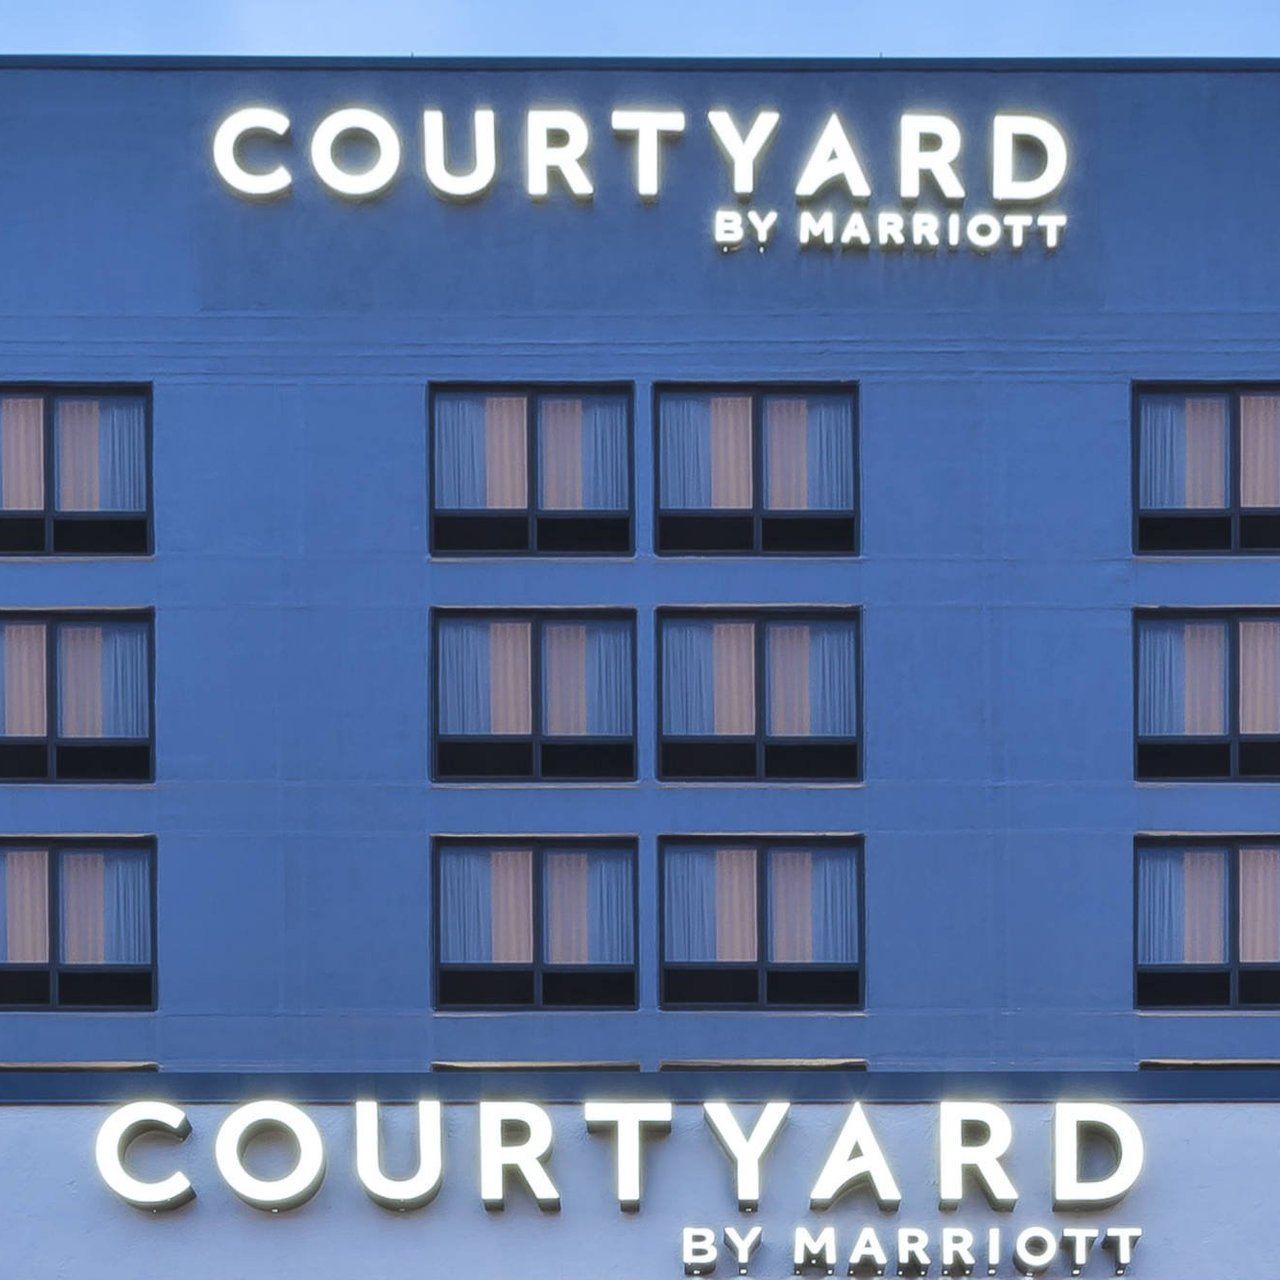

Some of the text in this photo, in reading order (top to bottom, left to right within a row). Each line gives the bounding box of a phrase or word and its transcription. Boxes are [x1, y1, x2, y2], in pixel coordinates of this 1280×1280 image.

[212, 107, 1068, 200] COURTYARD
[714, 210, 1067, 248] BY MARRIOTT
[94, 1099, 1145, 1205] COURTYARD
[682, 1226, 1143, 1267] BY MARRIOTT
